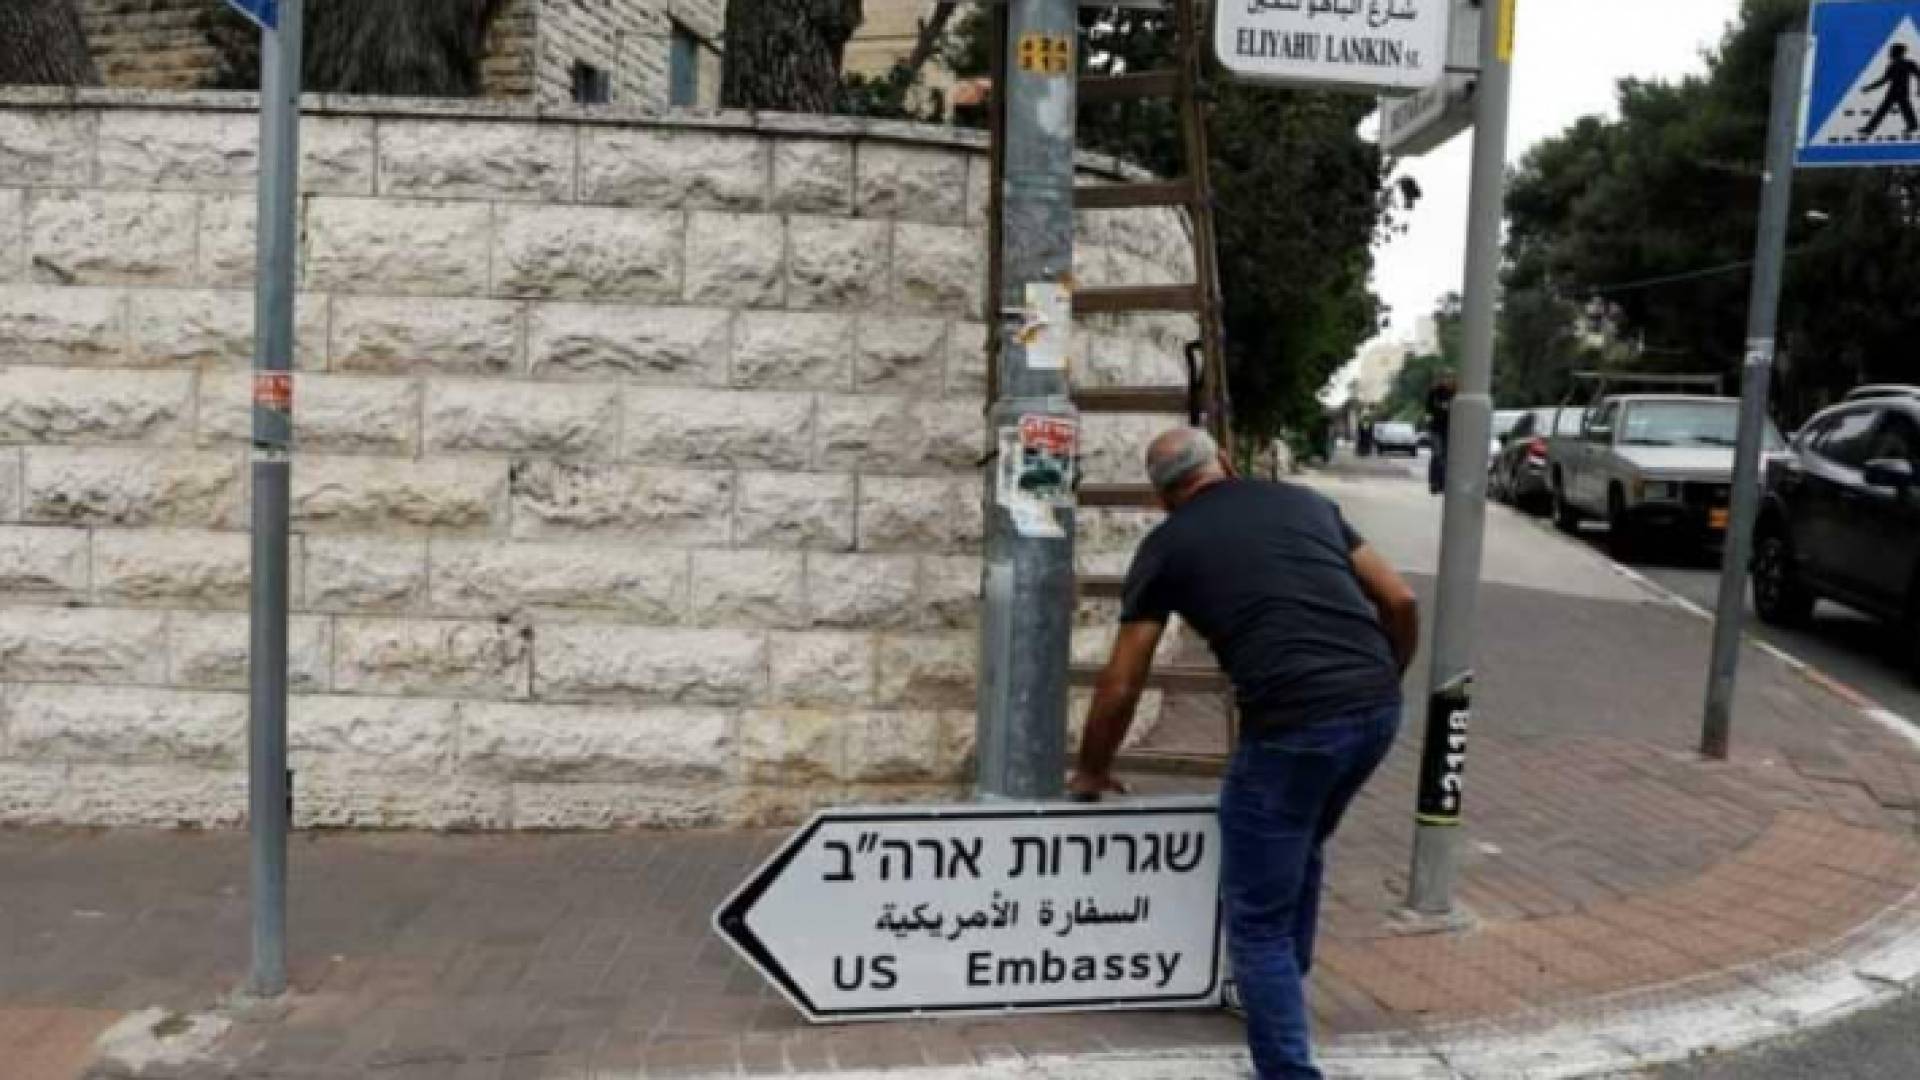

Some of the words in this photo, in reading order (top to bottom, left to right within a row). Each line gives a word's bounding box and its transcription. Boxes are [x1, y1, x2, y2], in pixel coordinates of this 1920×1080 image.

[1235, 27, 1320, 61] ELIYAHU
[1325, 34, 1403, 66] LANKIN
[1007, 831, 1205, 878] שגרירות
[874, 889, 1020, 942] الأمريكية
[1039, 895, 1150, 937] السفارة
[832, 954, 899, 992] US
[966, 948, 1182, 988] Embassy
